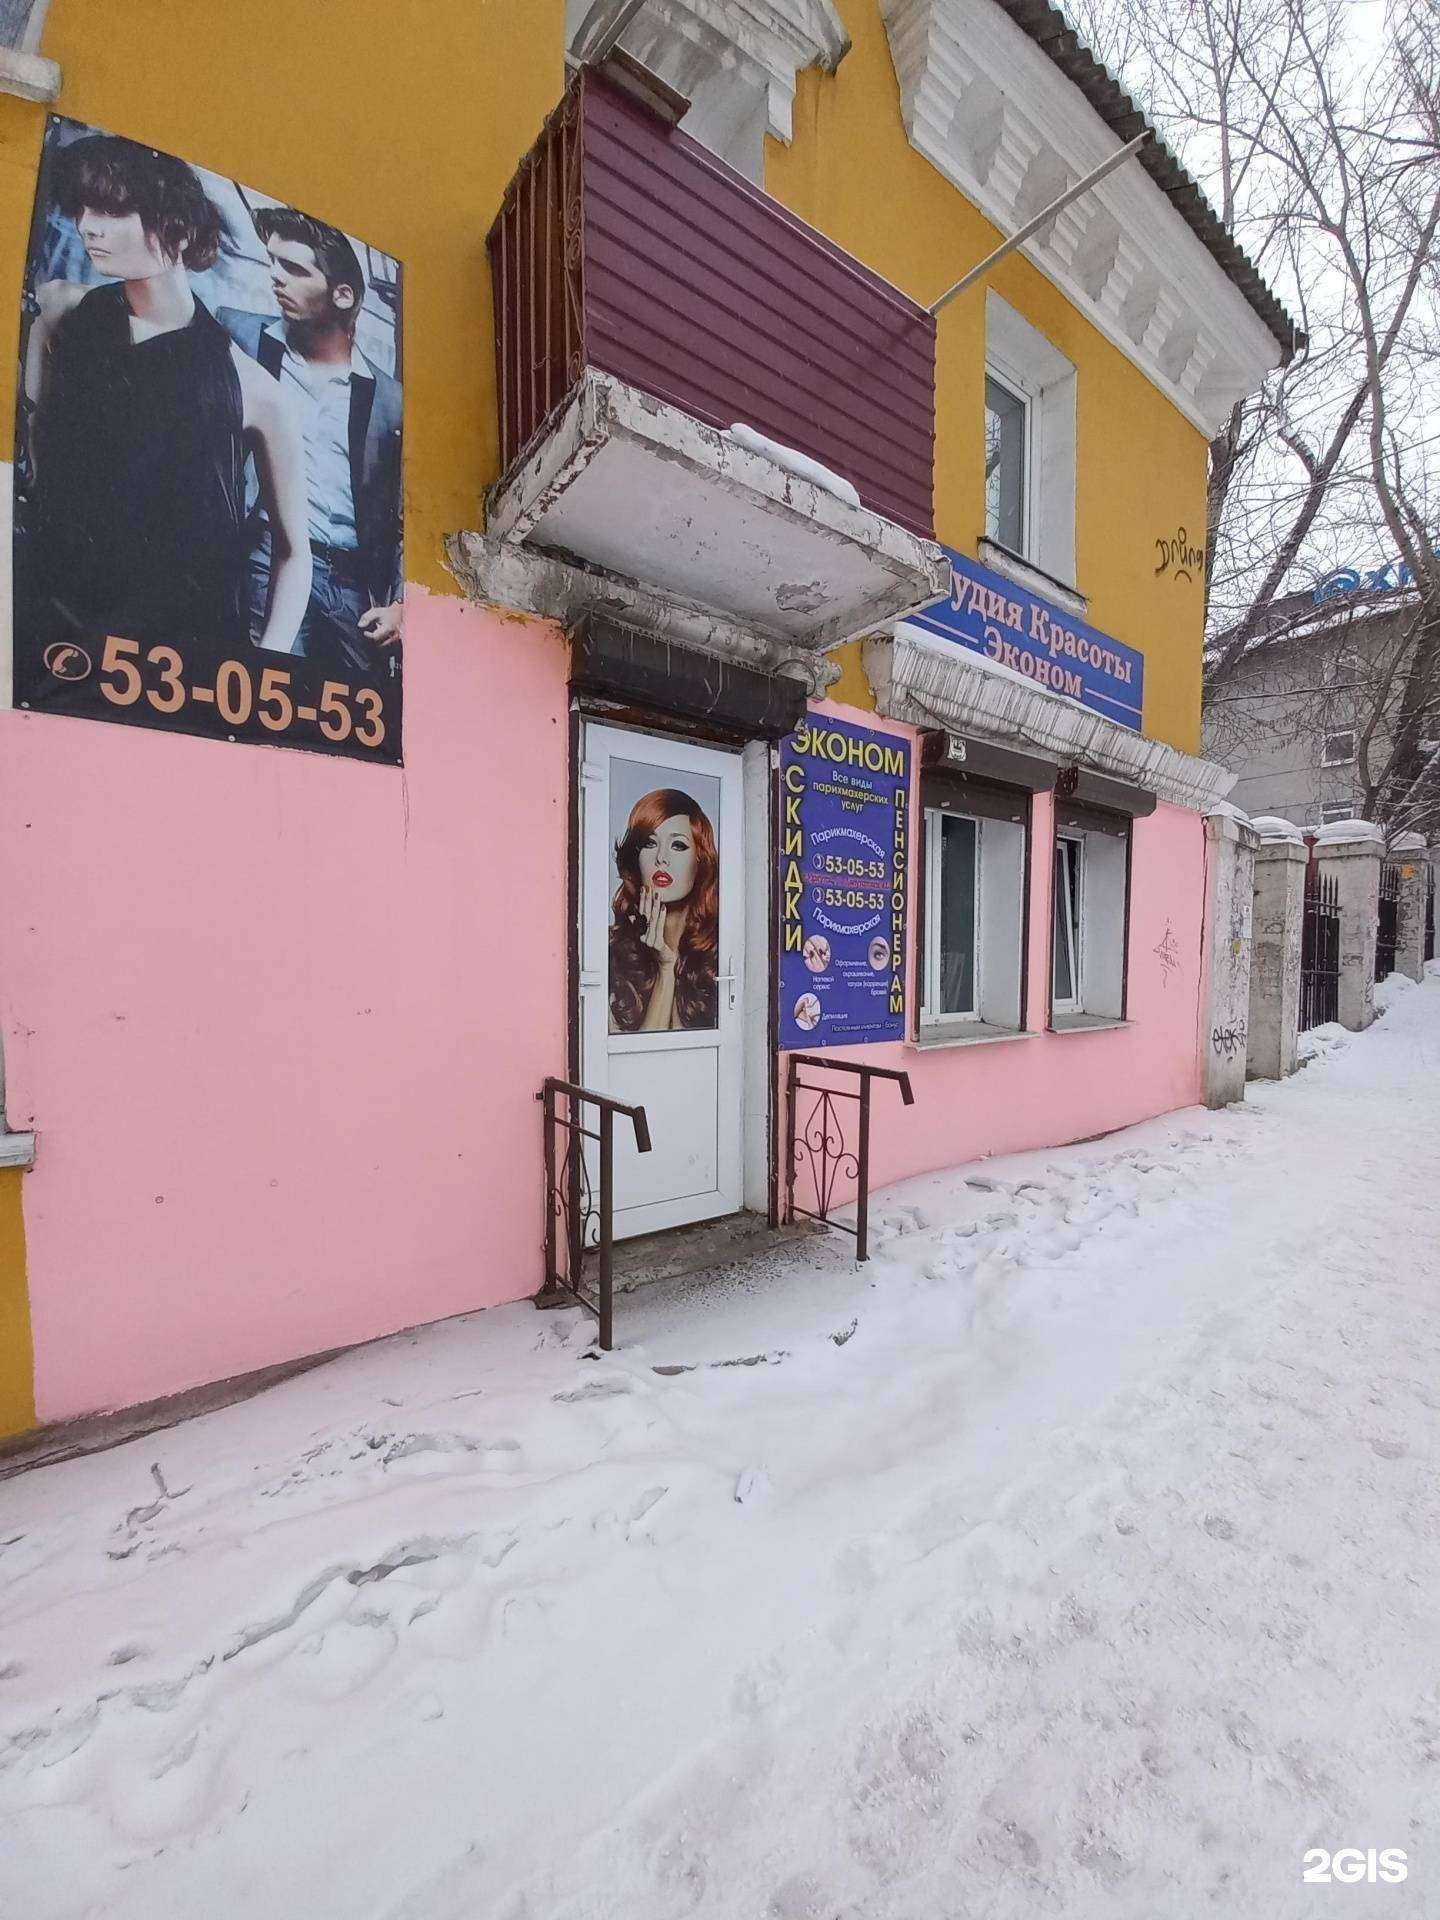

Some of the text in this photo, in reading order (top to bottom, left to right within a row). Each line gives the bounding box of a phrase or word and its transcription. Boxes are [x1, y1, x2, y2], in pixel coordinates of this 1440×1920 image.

[950, 571, 1133, 684] удия Красоты
[982, 624, 1083, 699] Эконом
[99, 634, 386, 748] 53-05-53
[790, 725, 905, 778] ЭКОНОМ
[832, 770, 873, 790] Все виды
[841, 799, 865, 814] услуг
[784, 764, 805, 952] СКИДКИ
[809, 827, 887, 860] Парикмахерская
[825, 855, 886, 879] 53-05-53
[824, 888, 885, 910] 53-05-53
[889, 788, 906, 1014] ПЕНСИОНЕРАМ
